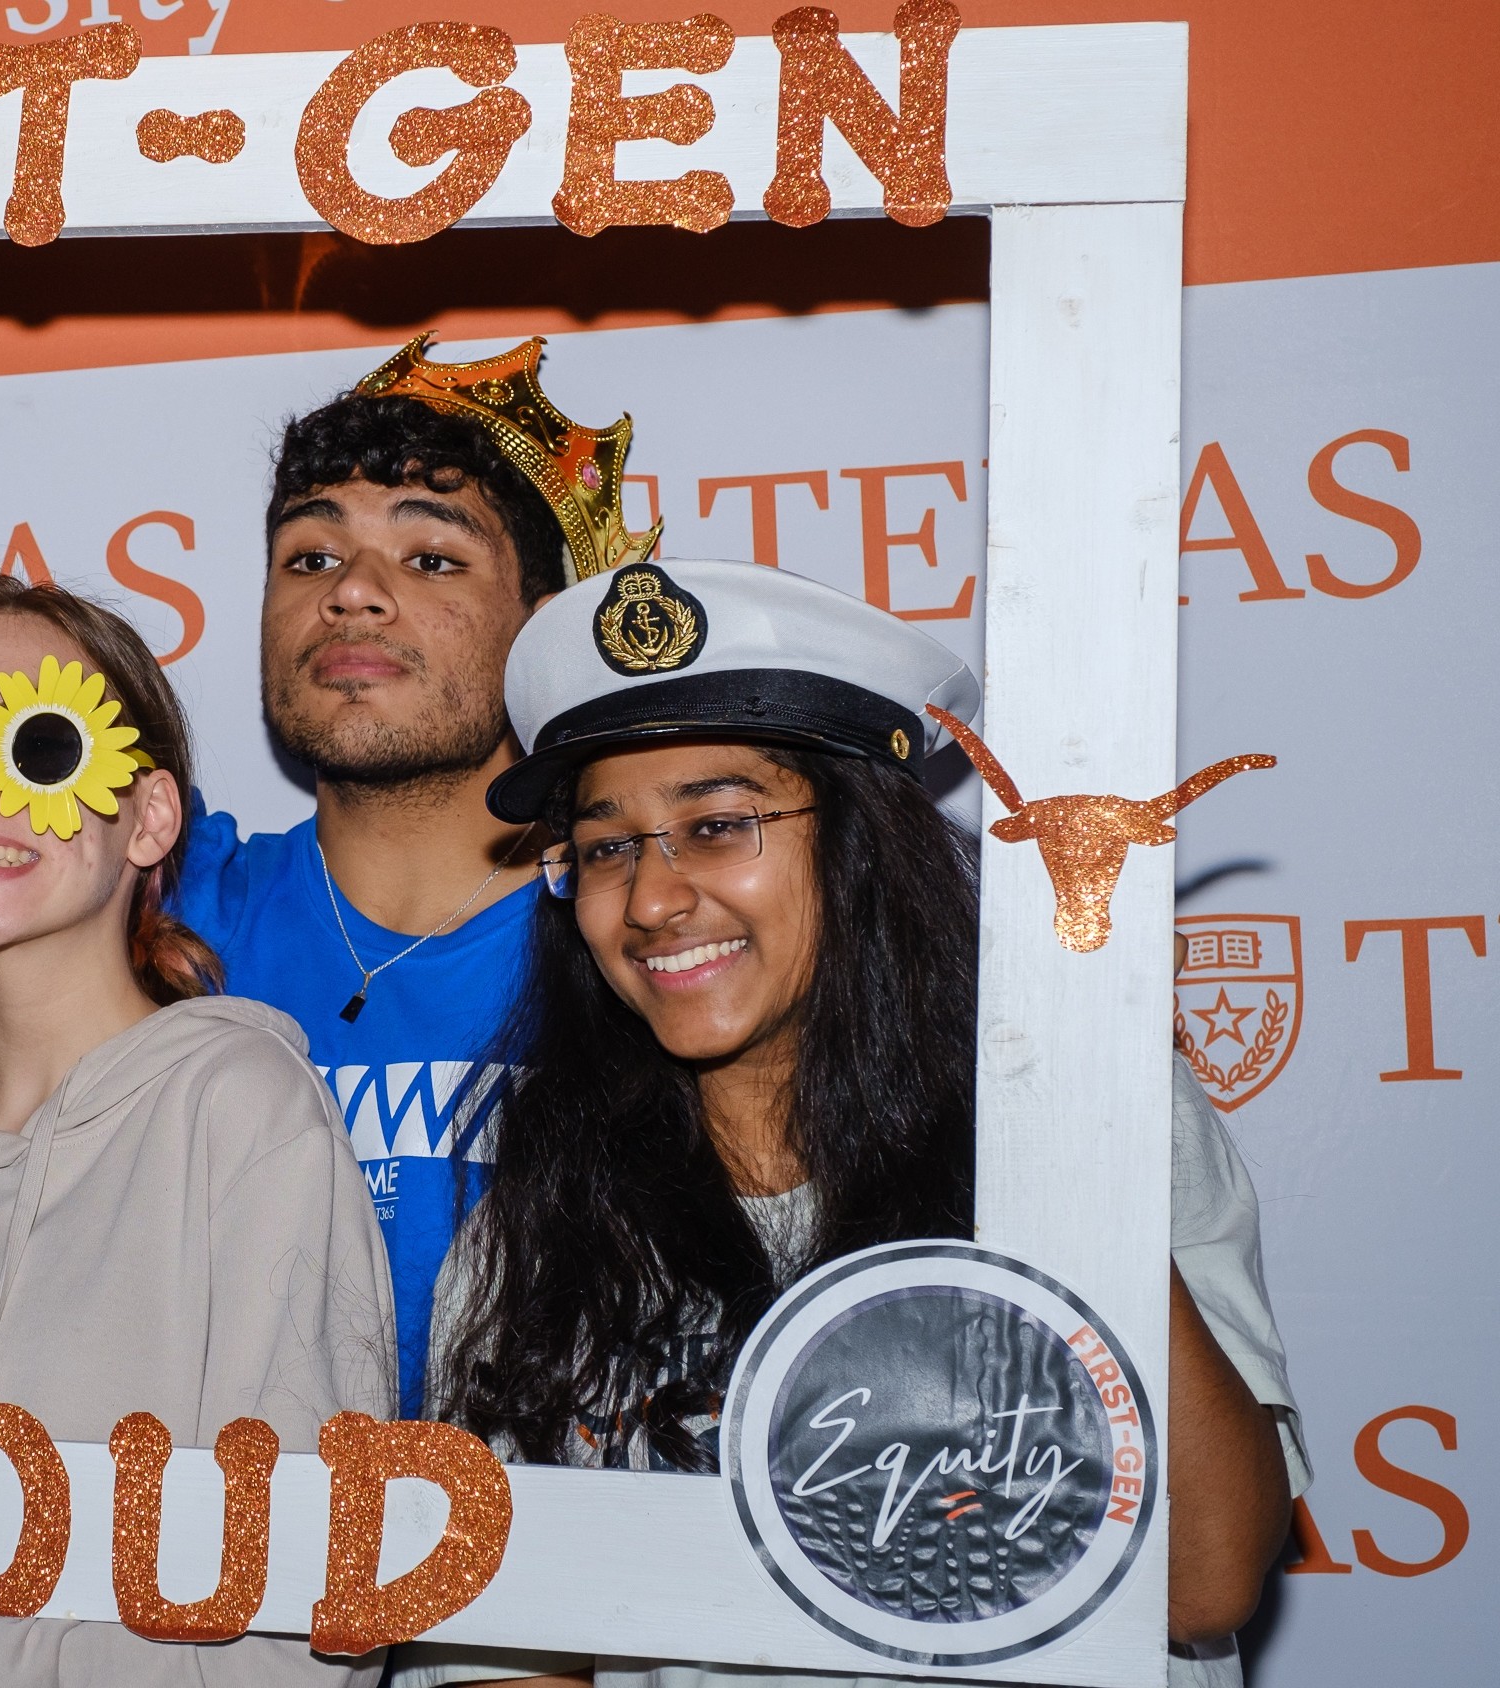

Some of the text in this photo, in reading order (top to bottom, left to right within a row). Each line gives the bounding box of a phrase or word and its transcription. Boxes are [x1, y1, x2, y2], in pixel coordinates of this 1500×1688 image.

[699, 428, 1422, 622] TEAS
[792, 1387, 1084, 1547] Equity
[1067, 1324, 1144, 1525] FIRST-GEN
